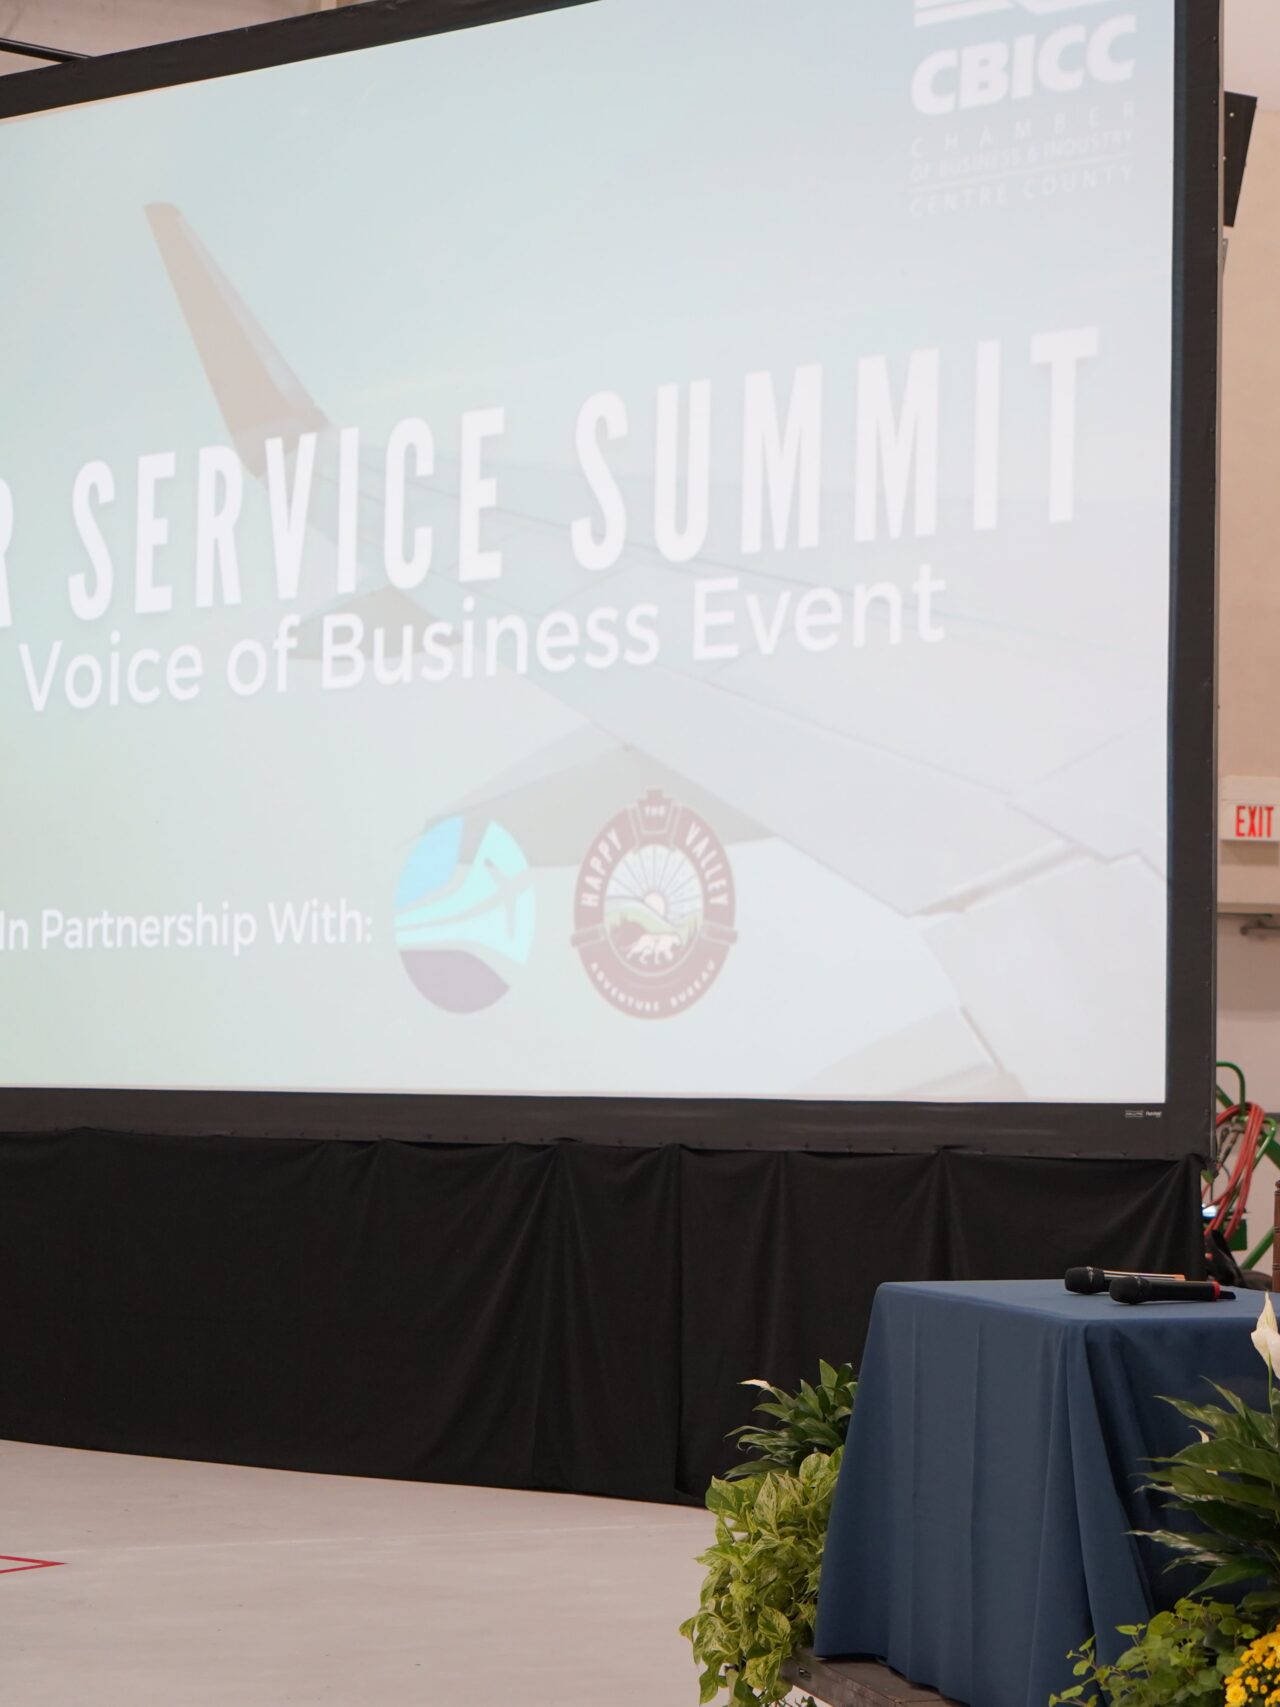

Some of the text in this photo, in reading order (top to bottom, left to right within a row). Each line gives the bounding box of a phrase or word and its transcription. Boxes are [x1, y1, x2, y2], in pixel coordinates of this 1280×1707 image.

[911, 14, 1137, 116] CBICC
[67, 406, 505, 622] SERVICE
[570, 325, 1099, 572] SUMMIT
[18, 563, 946, 712] Voice of Business Event
[581, 822, 729, 908] HAPPY VALLEY
[1235, 805, 1275, 838] EXIT
[0, 897, 373, 957] In Partnership With:
